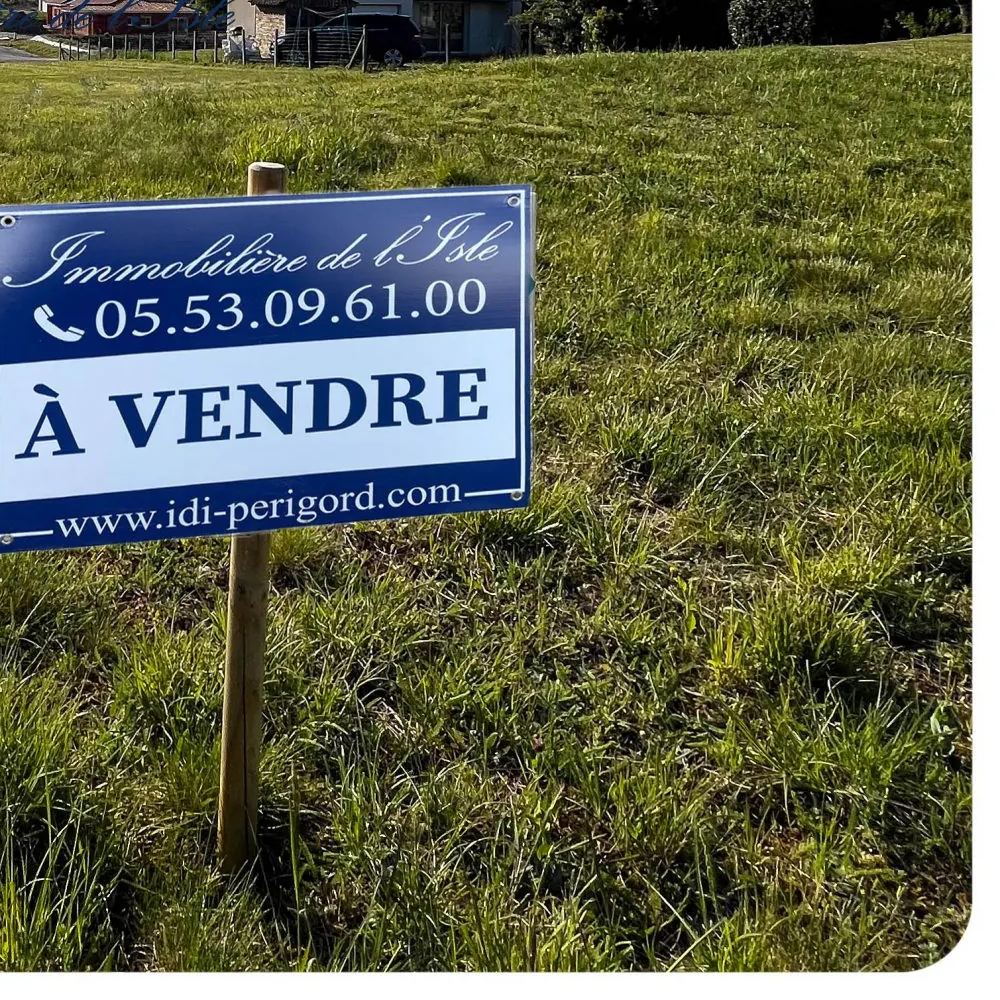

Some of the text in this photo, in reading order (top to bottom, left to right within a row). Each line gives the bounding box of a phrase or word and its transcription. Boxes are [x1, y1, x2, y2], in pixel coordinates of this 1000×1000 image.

[2, 230, 308, 288] Immobilière
[316, 232, 368, 271] de
[94, 277, 487, 340] 05.53.09.61.00
[14, 367, 490, 460] À VENDRE
[55, 482, 462, 539] www.idi-perigord.com
